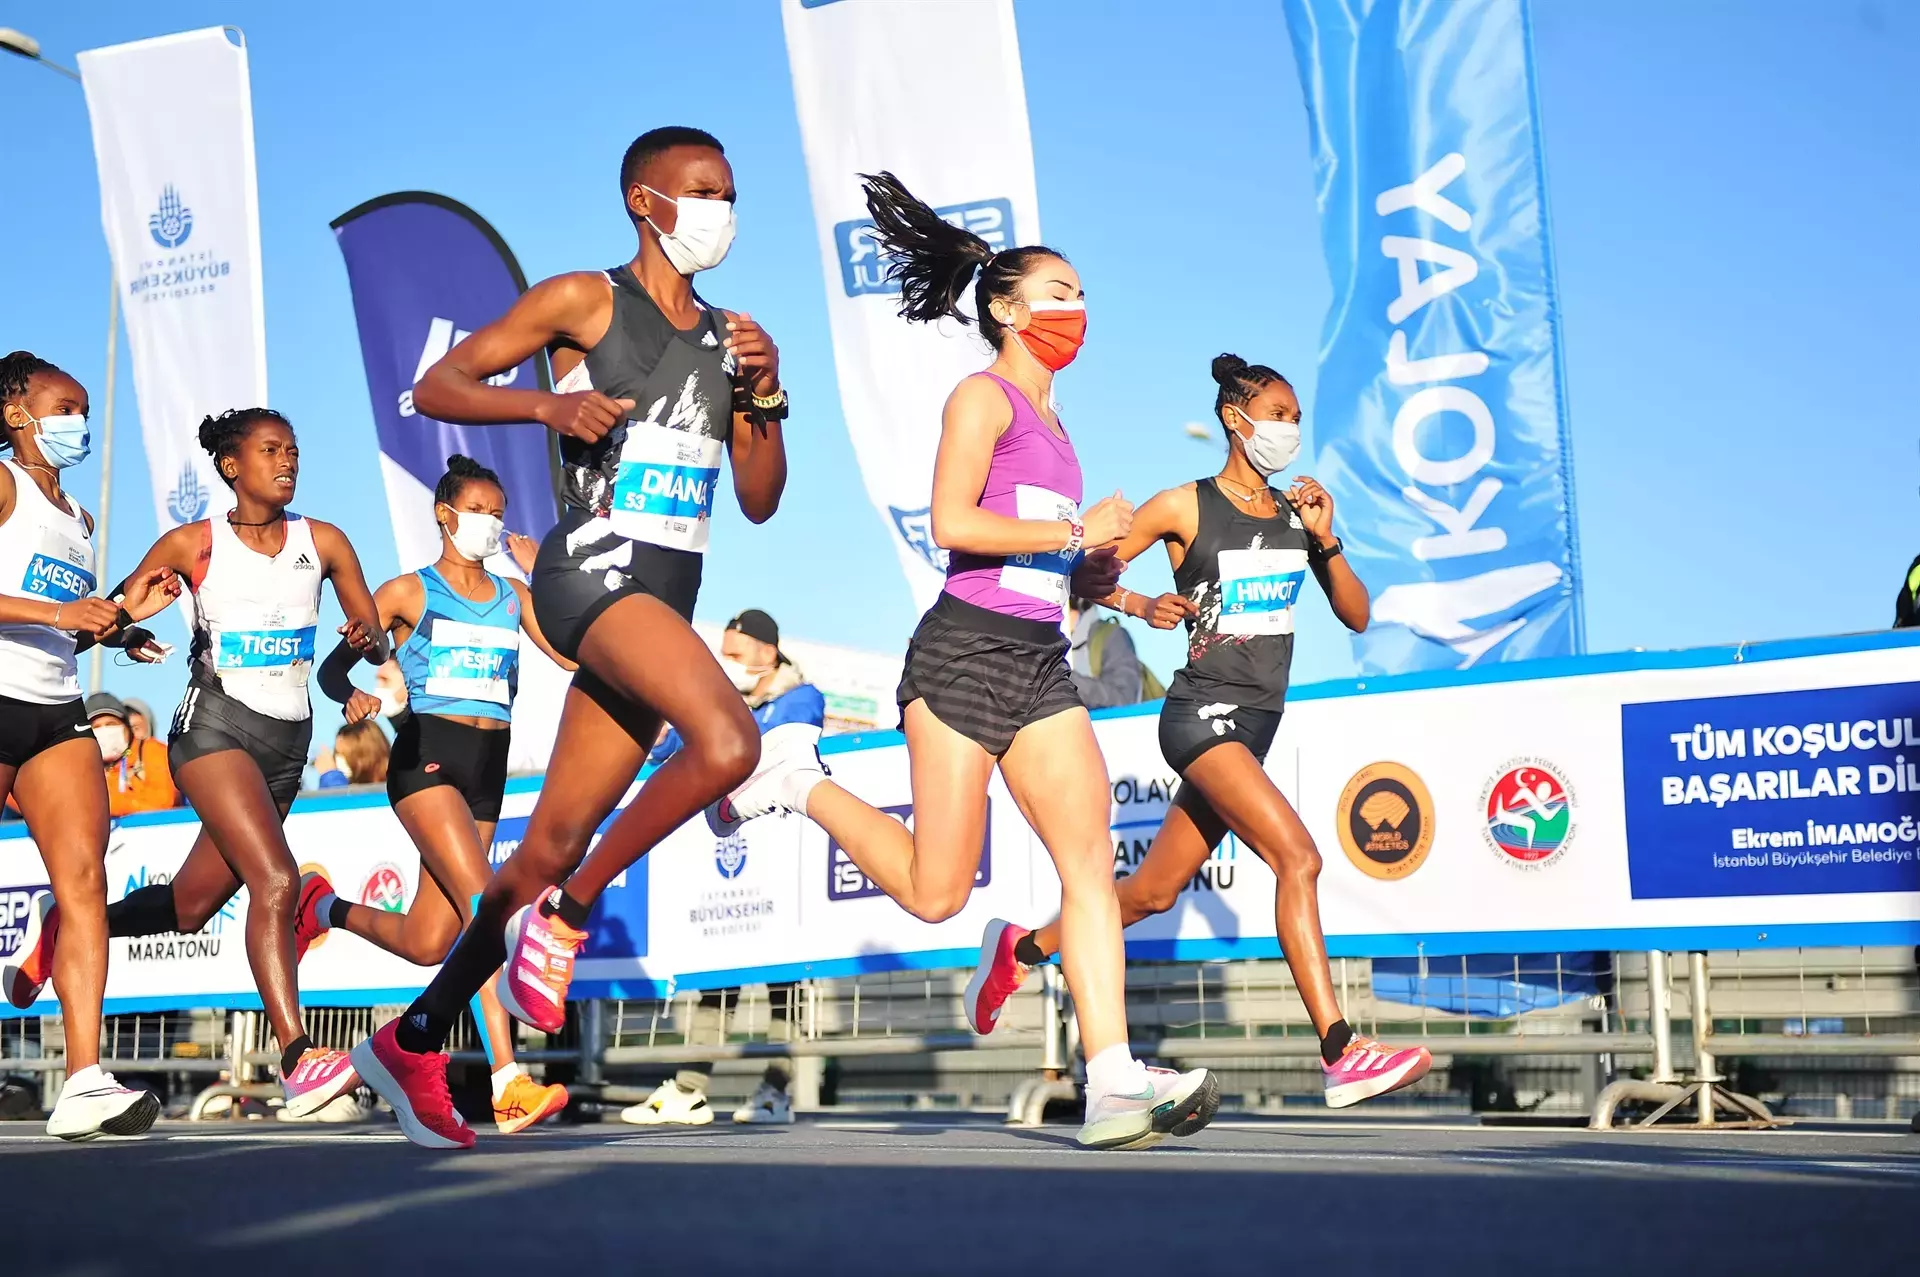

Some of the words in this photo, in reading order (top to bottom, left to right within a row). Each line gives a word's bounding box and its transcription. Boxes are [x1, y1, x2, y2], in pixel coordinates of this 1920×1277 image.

[641, 468, 708, 506] DIANA
[624, 491, 646, 511] 53
[293, 562, 315, 570] adidas
[29, 578, 48, 593] 57
[1236, 580, 1297, 602] HIWOT
[240, 634, 302, 656] TIGIST
[1670, 723, 1747, 761] TÜM
[1110, 777, 1177, 805] OLAY
[1661, 766, 1861, 808] BAŞARILAR
[1731, 827, 1804, 849] Ekrem
[1806, 814, 1920, 847] İMAMOĞ
[1712, 852, 1769, 869] İstanbul
[1772, 849, 1848, 869] Büyükşehir
[1851, 846, 1913, 867] Belediye
[127, 938, 222, 962] MARATONU
